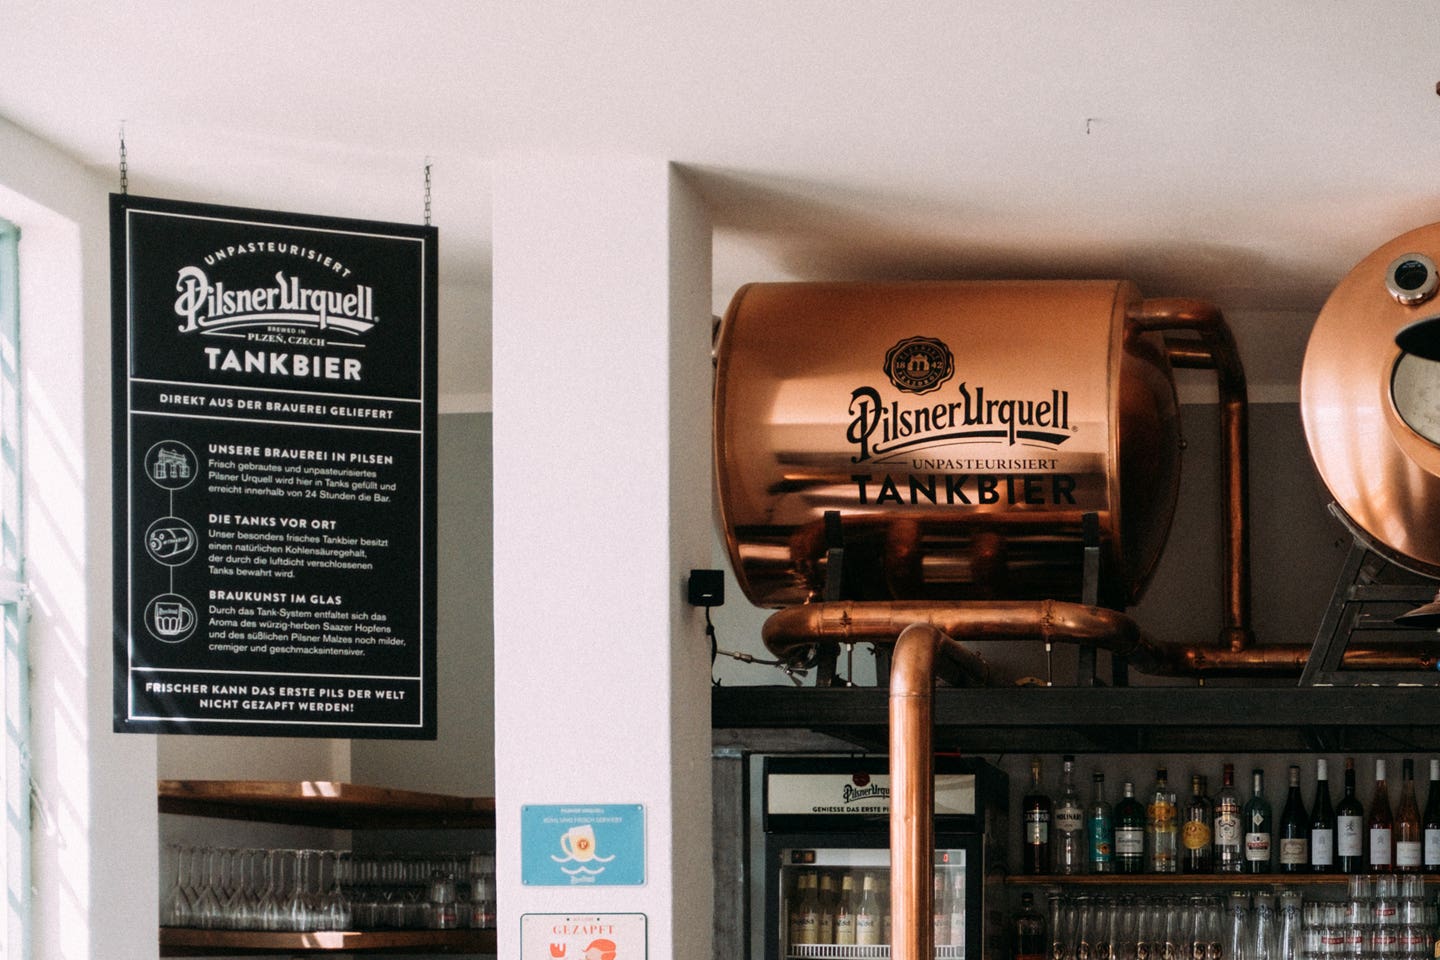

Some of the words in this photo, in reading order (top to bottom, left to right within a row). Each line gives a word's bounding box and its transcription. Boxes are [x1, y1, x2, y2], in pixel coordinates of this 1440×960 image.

[204, 242, 351, 278] UNPASTEURISIERT
[174, 266, 279, 333] Pilsner
[275, 271, 375, 330] Urquell
[267, 326, 295, 334] BREWED
[288, 336, 326, 347] CZECH
[204, 347, 362, 381] TANKBIER
[160, 393, 206, 406] DIREKT
[209, 396, 234, 408] AUS
[237, 398, 262, 410] DER
[266, 401, 327, 415] BRAUEREI
[330, 406, 393, 419] GELIEFERT
[846, 385, 962, 464] Pilsner
[959, 382, 1070, 446] Urquell
[208, 444, 260, 457] UNSERE
[264, 448, 328, 461] BRAUEREI
[332, 452, 346, 462] IN
[350, 453, 393, 465] PILSEN
[208, 459, 235, 470] Frisch
[238, 461, 282, 473] gebrautes
[284, 464, 301, 473] und
[303, 466, 377, 478] unpasteurisiertes
[912, 458, 1058, 470] UNPASTEURISIERT
[208, 471, 239, 482] Pilsner
[241, 474, 273, 485] Urquell
[275, 476, 294, 485] wird
[296, 477, 312, 486] hier
[315, 478, 323, 487] in
[325, 478, 349, 488] Tanks
[352, 480, 378, 491] gefüllt
[380, 482, 396, 491] und
[851, 473, 1077, 505] TANKBIER
[208, 485, 242, 494] erreicht
[244, 487, 284, 496] innerhalb
[305, 490, 317, 498] 24
[319, 491, 356, 501] Stunden
[358, 492, 371, 501] die
[373, 493, 391, 503] Bar.
[208, 514, 231, 524] DIE
[234, 515, 276, 527] TANKS
[280, 518, 307, 529] VOR
[311, 519, 337, 530] ORT
[208, 529, 235, 539] Unser
[237, 531, 284, 542] besonders
[286, 533, 320, 543] frisches
[322, 535, 358, 545] Tankbier
[360, 537, 388, 547] besitzt
[235, 543, 283, 553] natürlichen
[208, 554, 223, 562] der
[225, 555, 251, 564] durch
[253, 557, 267, 565] die
[269, 557, 304, 567] luftdicht
[306, 559, 373, 570] verschlossenen
[208, 566, 233, 575] Tanks
[236, 567, 272, 577] bewahrt
[274, 569, 295, 578] wird.
[209, 590, 286, 603] BRAUKUNST
[291, 593, 306, 603] IM
[310, 595, 342, 605] GLAS
[209, 606, 236, 616] Durch
[238, 607, 254, 616] das
[256, 608, 312, 620] Tank-System
[314, 610, 349, 620] entfaltet
[351, 612, 368, 621] sich
[371, 613, 386, 621] das
[208, 618, 238, 628] Aroma
[240, 619, 257, 628] des
[259, 620, 320, 632] würzig-herben
[323, 622, 352, 631] Saazer
[355, 623, 391, 635] Hopfens
[209, 630, 225, 639] und
[228, 631, 244, 640] des
[247, 632, 288, 642] süßlichen
[291, 633, 320, 643] Pilsner
[322, 634, 352, 644] Malzes
[354, 635, 376, 645] noch
[378, 636, 406, 647] milder,
[209, 642, 248, 654] cremiger
[250, 644, 267, 653] und
[269, 645, 365, 657] geschmacksintensiver.
[145, 682, 208, 694] FRISCHER
[212, 685, 247, 696] KANN
[252, 686, 275, 696] DAS
[279, 687, 315, 697] ERSTE
[319, 689, 344, 698] PILS
[348, 690, 371, 699] DER
[375, 690, 405, 700] WELT
[200, 699, 238, 709] NICHT
[242, 701, 295, 711] GEZAPFT
[298, 702, 354, 713] WERDEN!
[843, 784, 872, 804] Pilsner
[870, 783, 890, 799] Urqu
